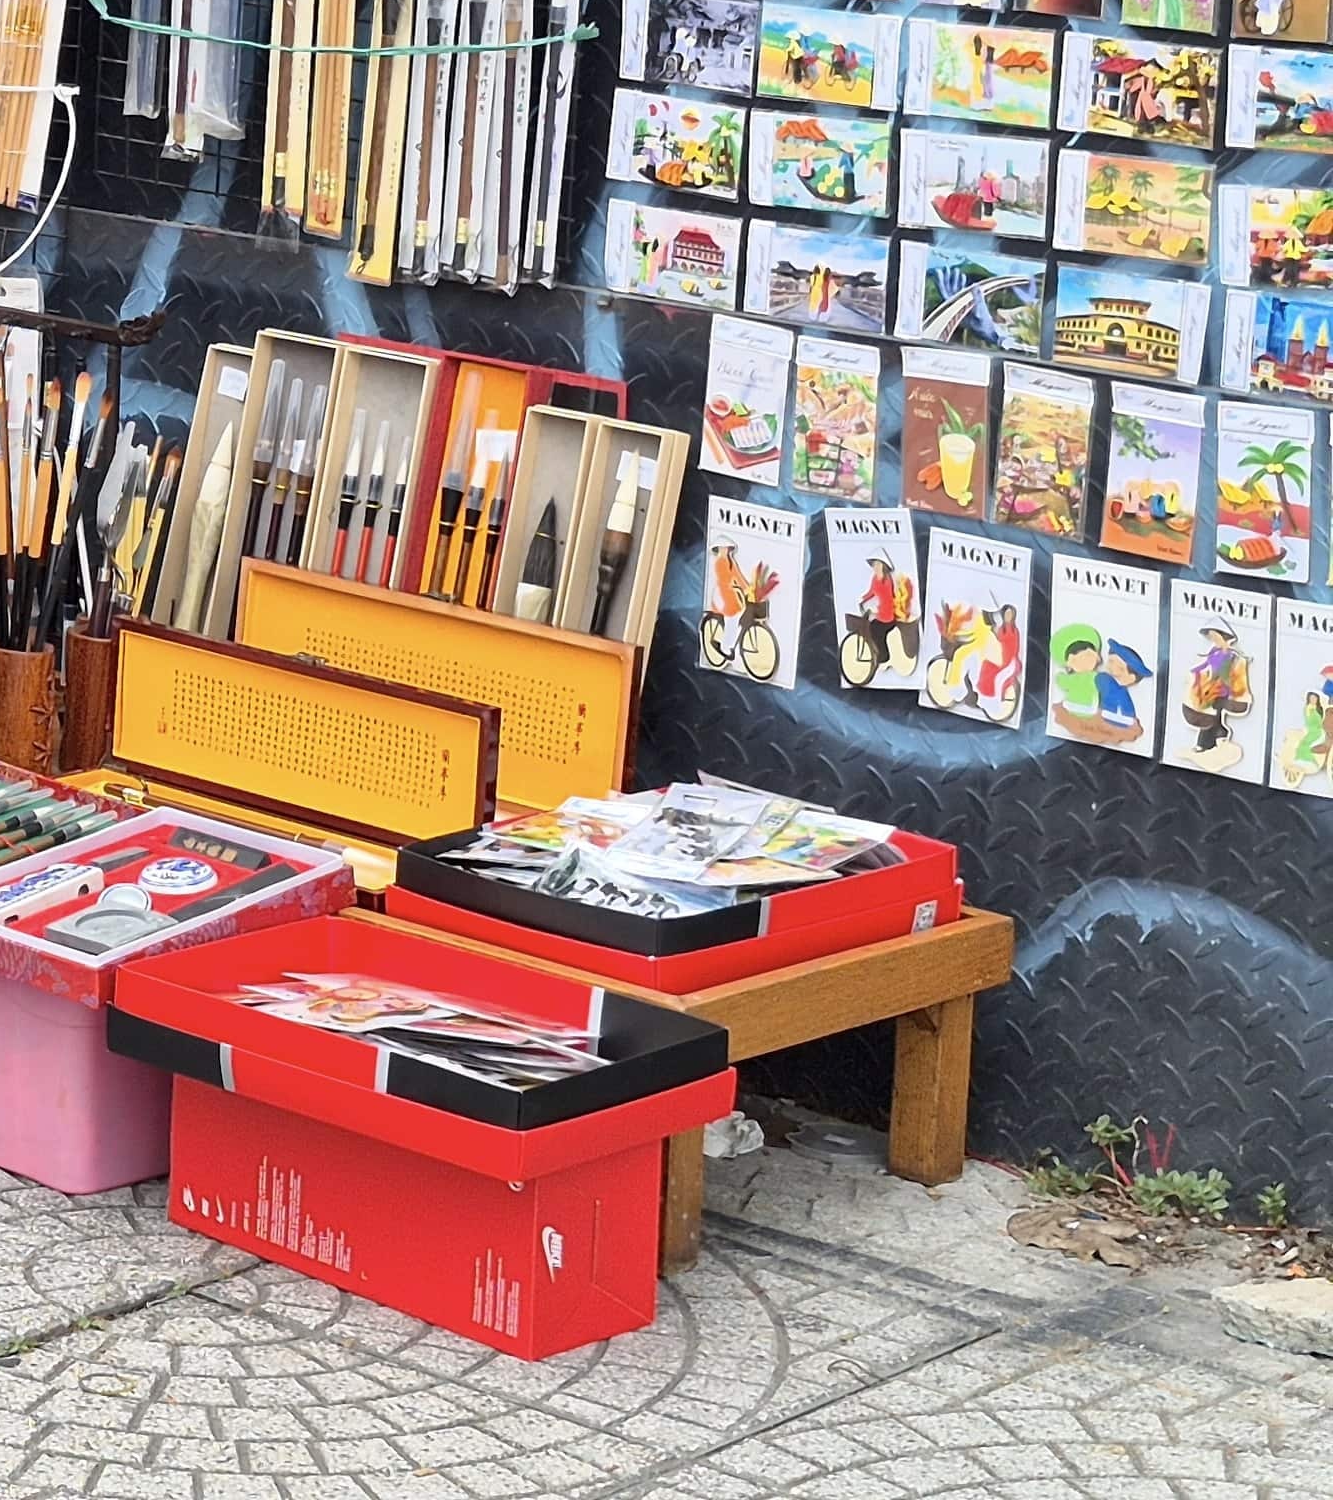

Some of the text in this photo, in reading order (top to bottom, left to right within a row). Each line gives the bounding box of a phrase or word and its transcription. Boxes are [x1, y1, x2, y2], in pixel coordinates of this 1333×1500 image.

[717, 507, 797, 538] MAGNET
[834, 518, 902, 536] MAGNET
[939, 540, 1022, 572] MAGNET
[1063, 566, 1150, 597] MAGNET
[1181, 590, 1263, 621] MAGNET
